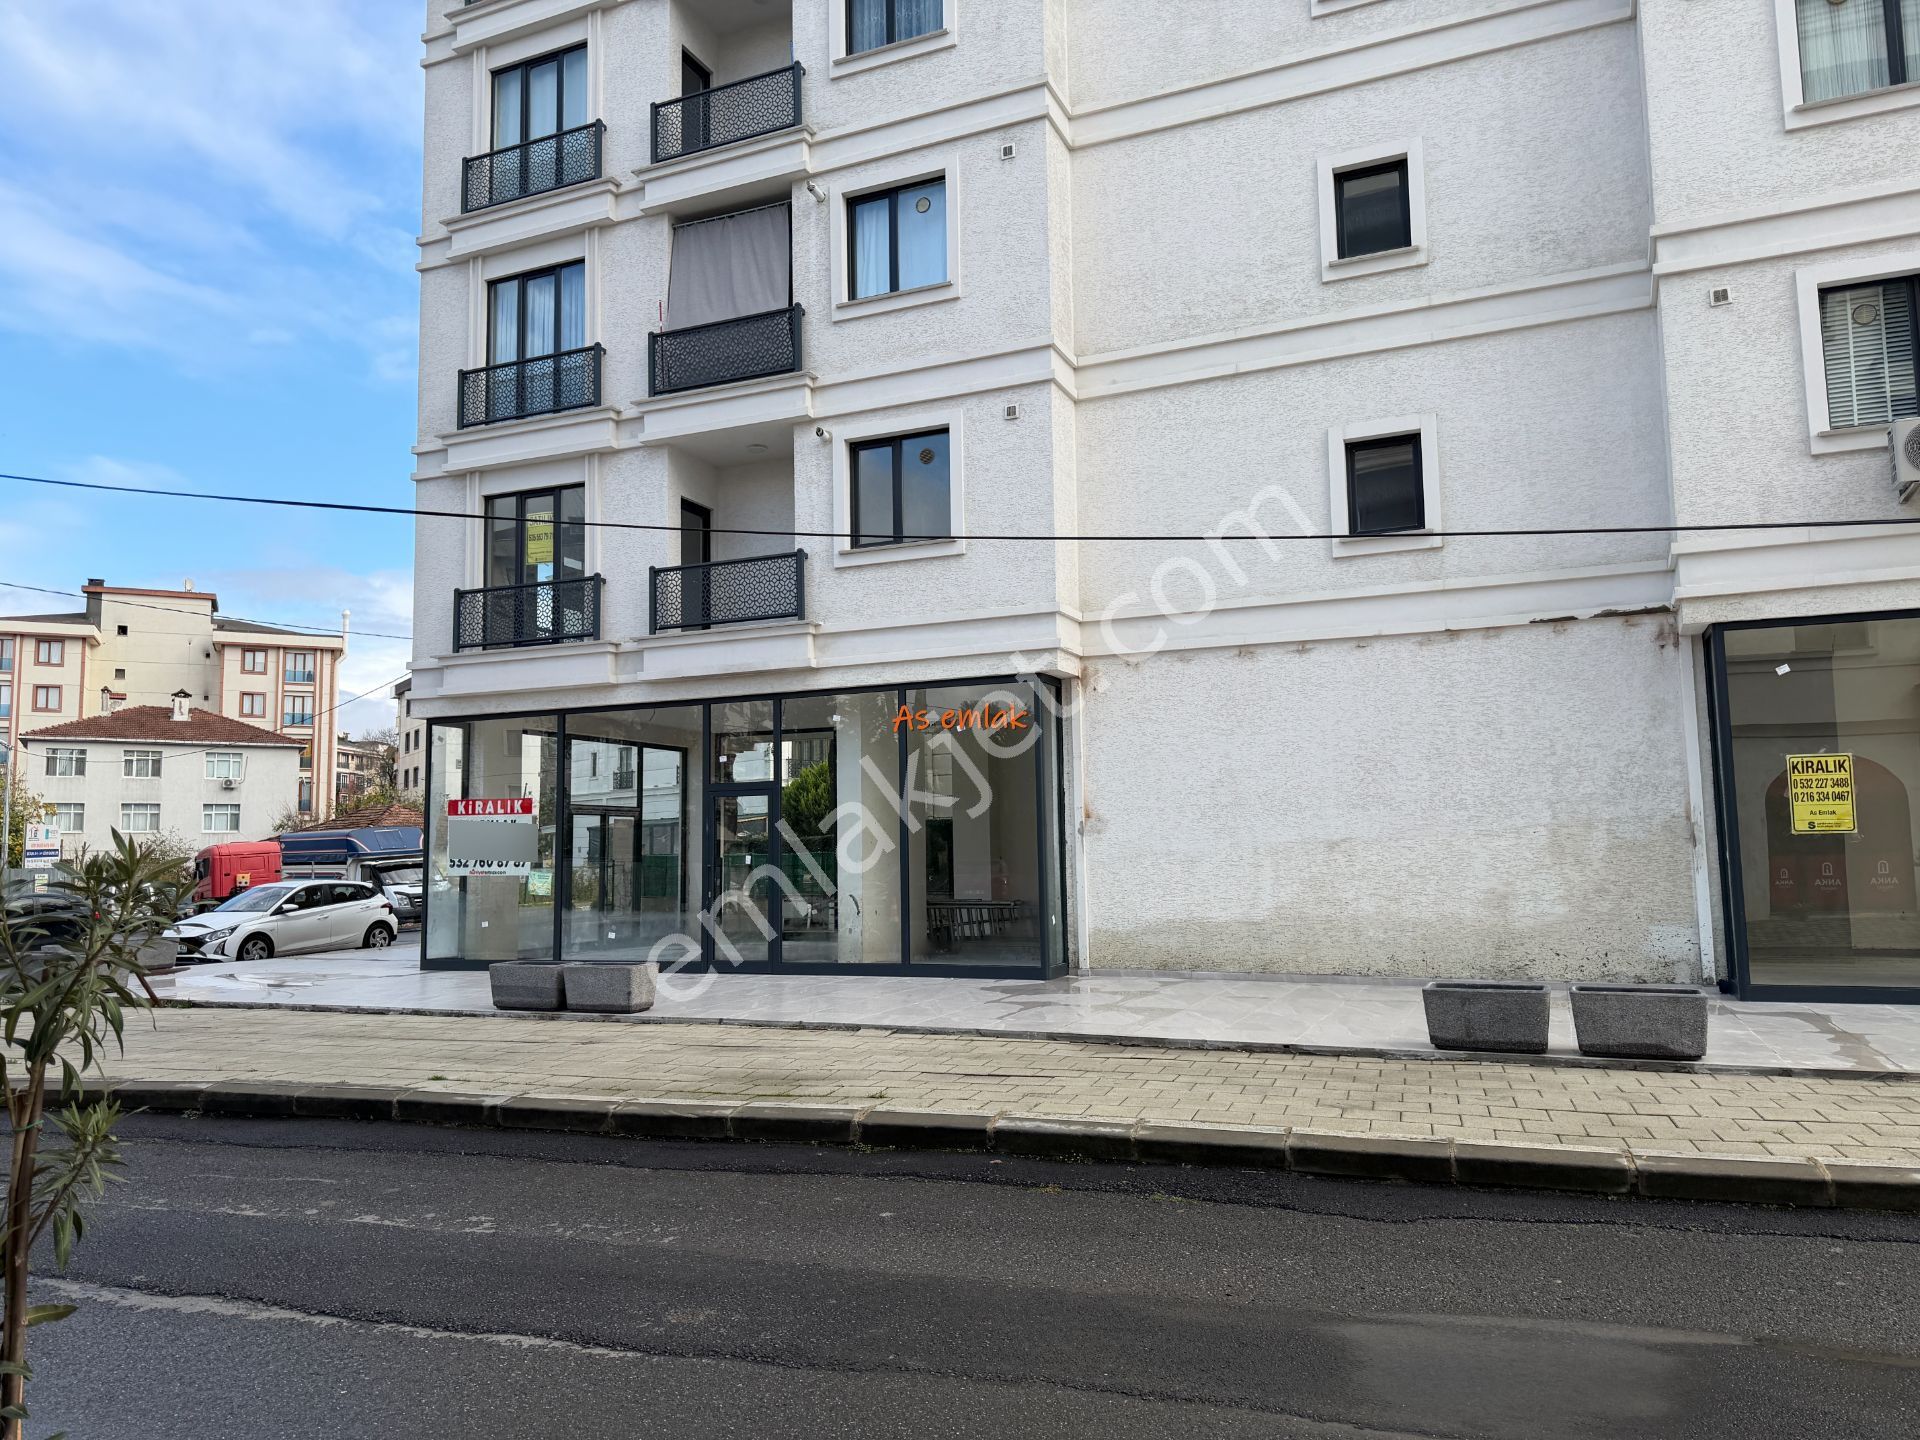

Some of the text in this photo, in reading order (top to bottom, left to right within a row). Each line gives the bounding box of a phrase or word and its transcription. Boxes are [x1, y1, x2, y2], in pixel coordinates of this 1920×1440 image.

[1791, 758, 1848, 775] KİRALIK
[1793, 777, 1849, 789] 0 532 227 3488
[1794, 790, 1850, 803] 0 216 334 0467
